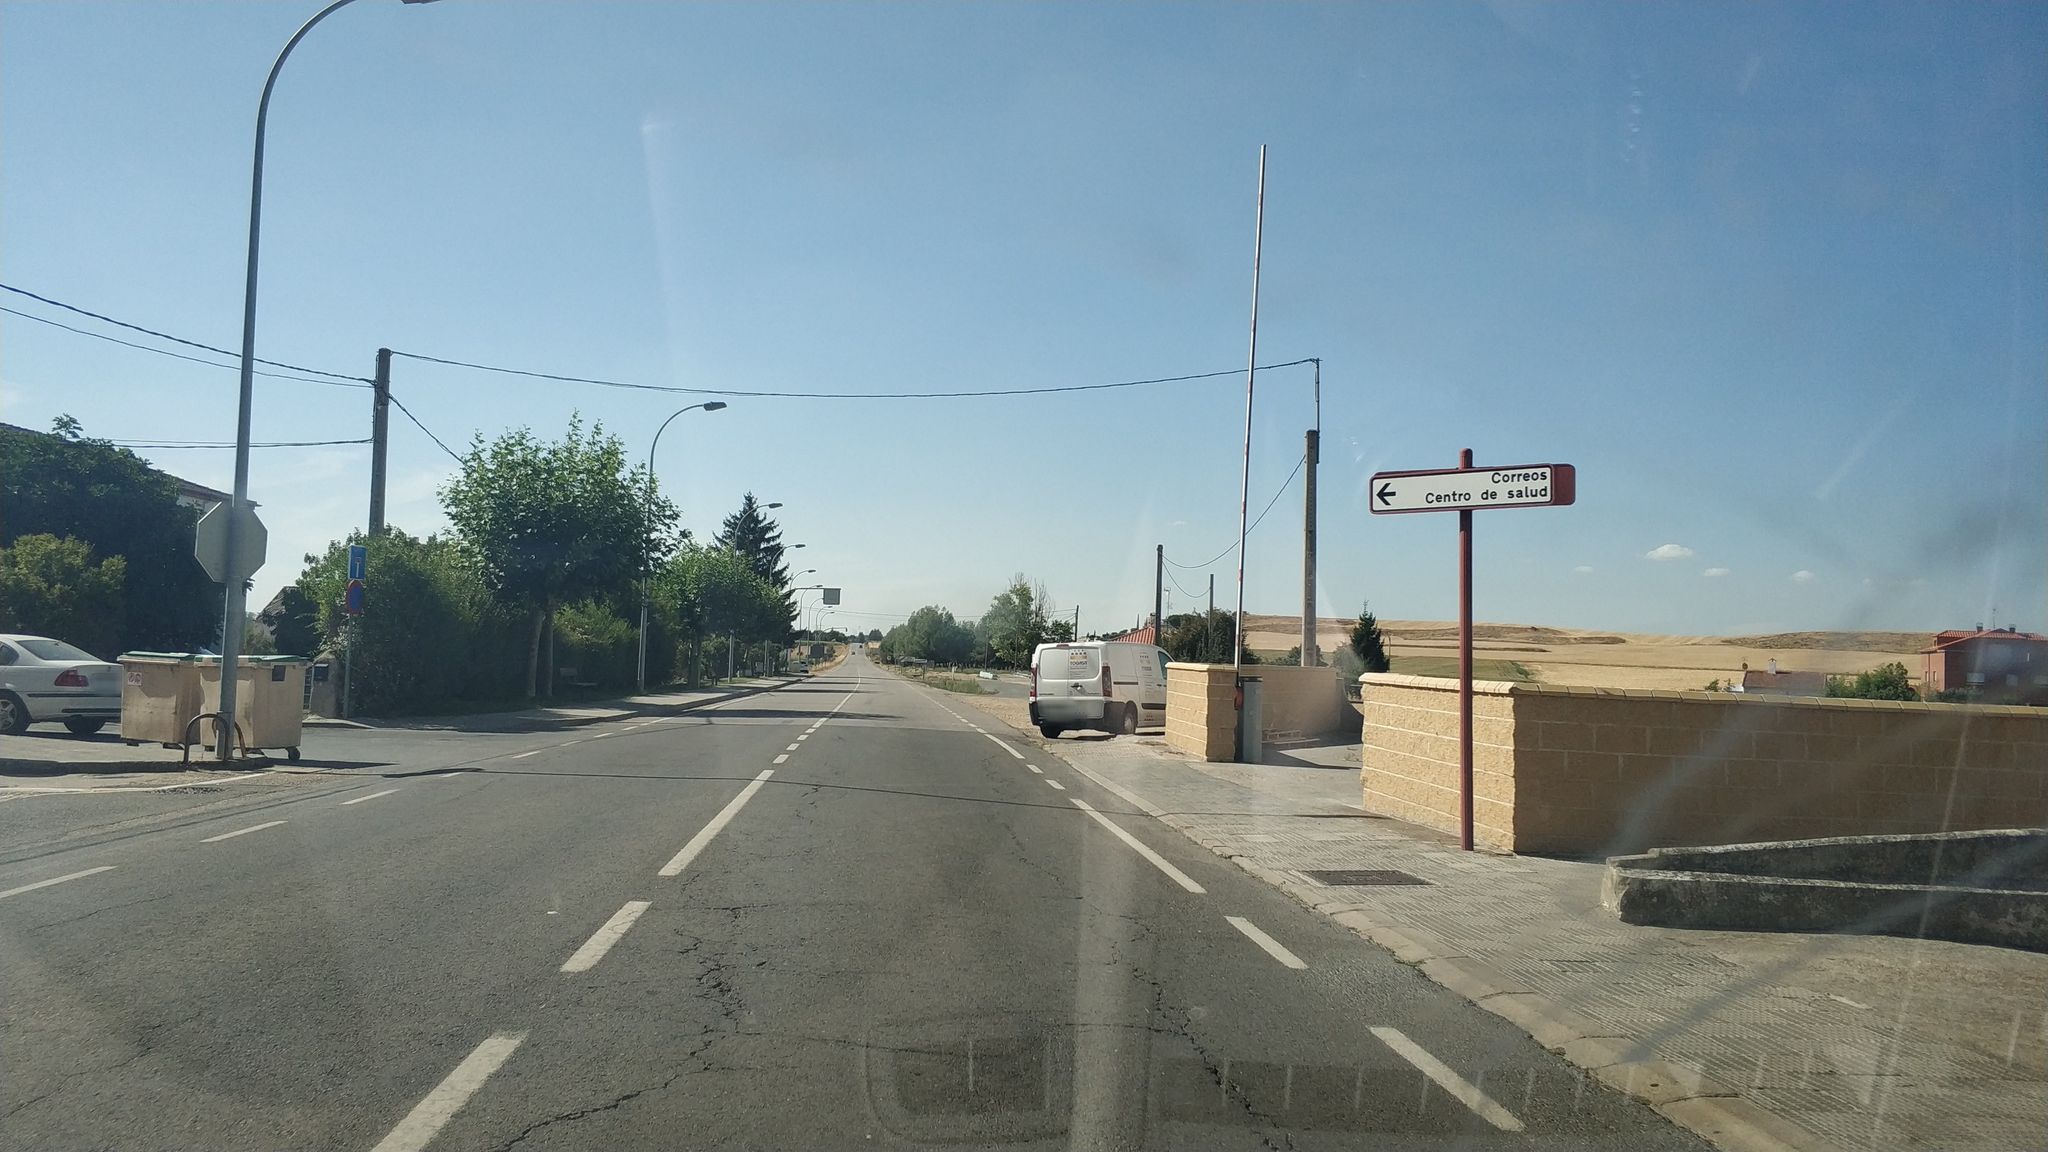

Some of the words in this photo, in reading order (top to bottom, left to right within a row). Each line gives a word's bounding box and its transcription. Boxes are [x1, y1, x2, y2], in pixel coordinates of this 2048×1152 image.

[1491, 471, 1548, 484] Correos
[1425, 492, 1471, 504] Centro
[1480, 488, 1497, 500] de
[1507, 486, 1548, 499] salud
